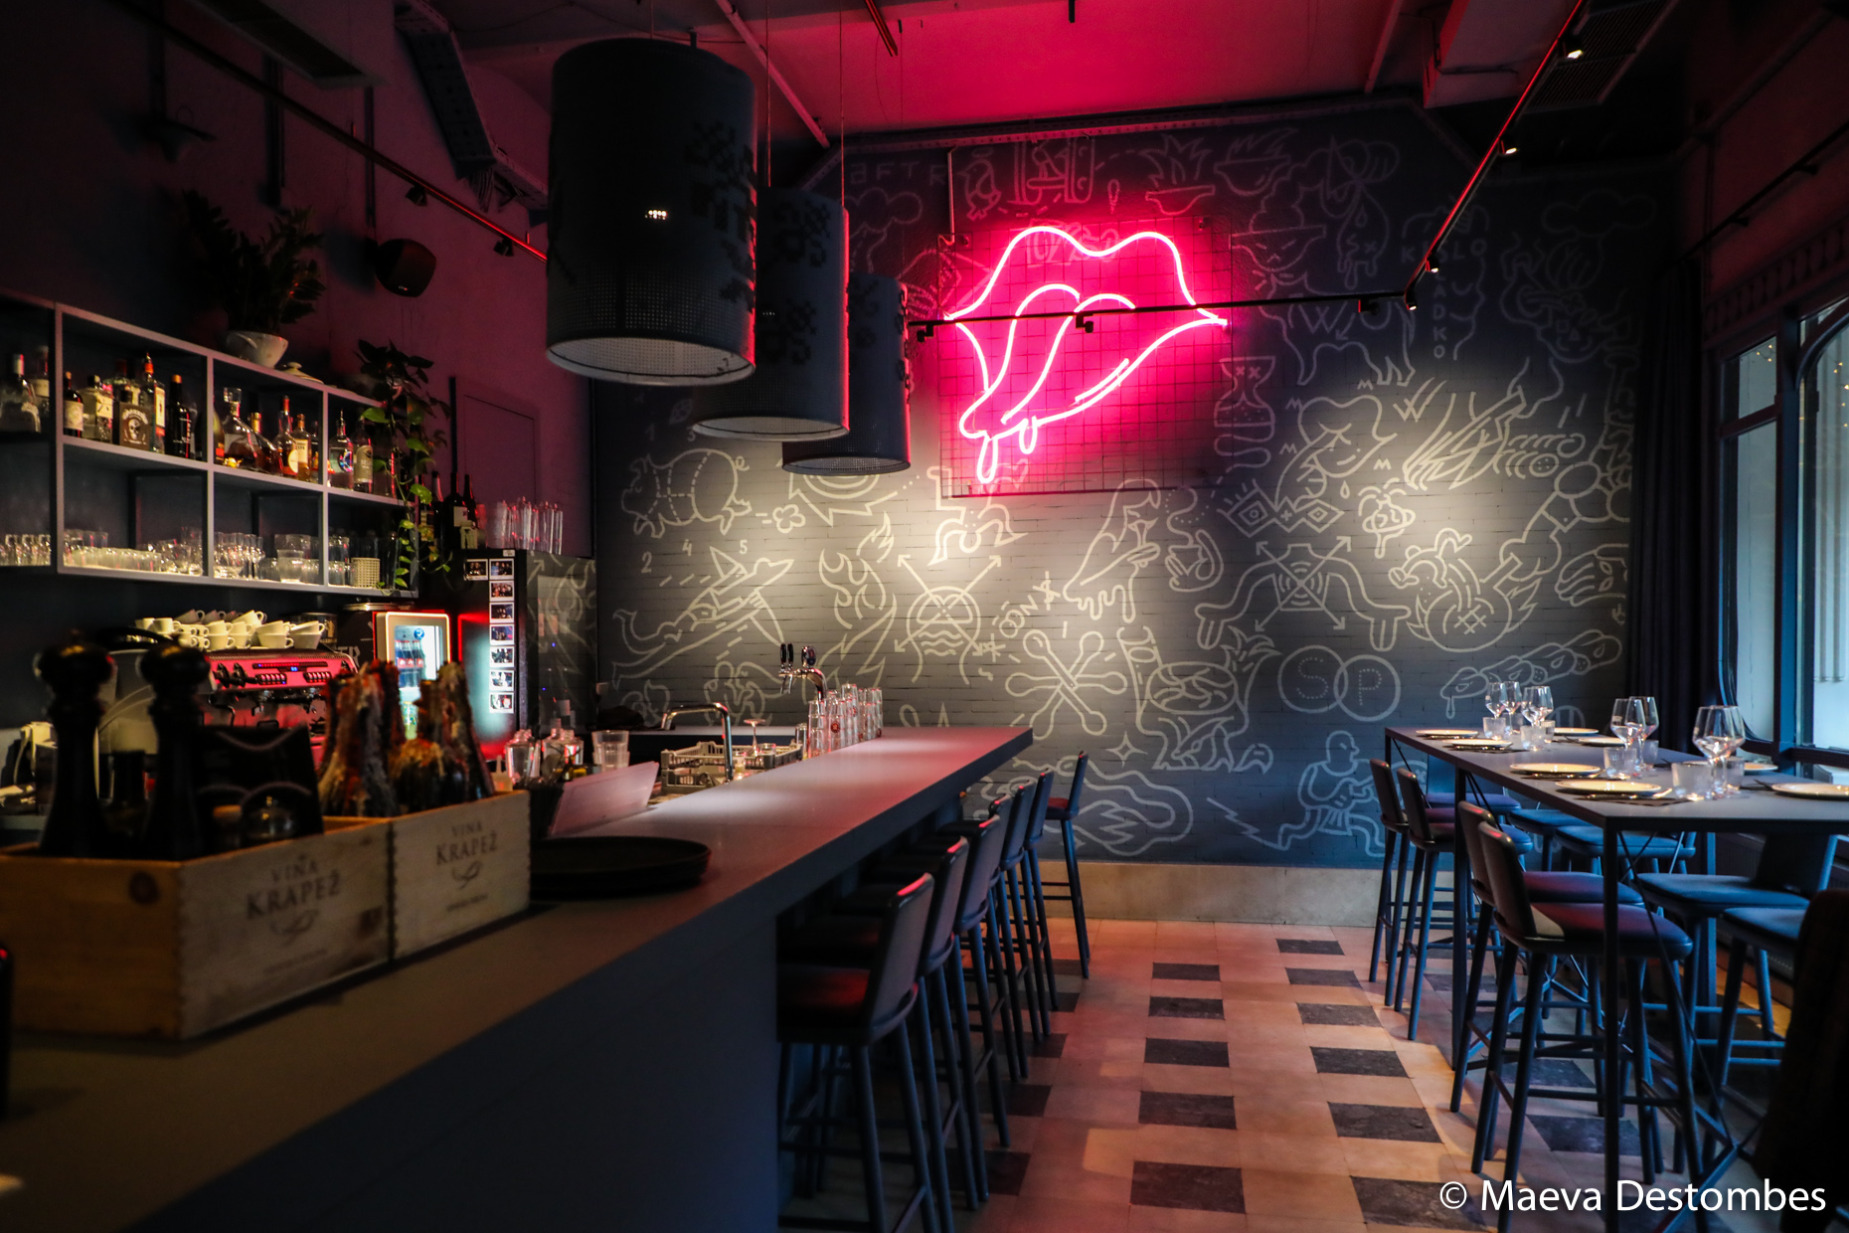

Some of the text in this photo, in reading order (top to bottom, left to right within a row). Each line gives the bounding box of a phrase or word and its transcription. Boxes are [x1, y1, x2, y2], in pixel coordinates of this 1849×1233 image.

[682, 538, 693, 556] 4
[738, 539, 749, 554] 5
[641, 551, 652, 573] 2
